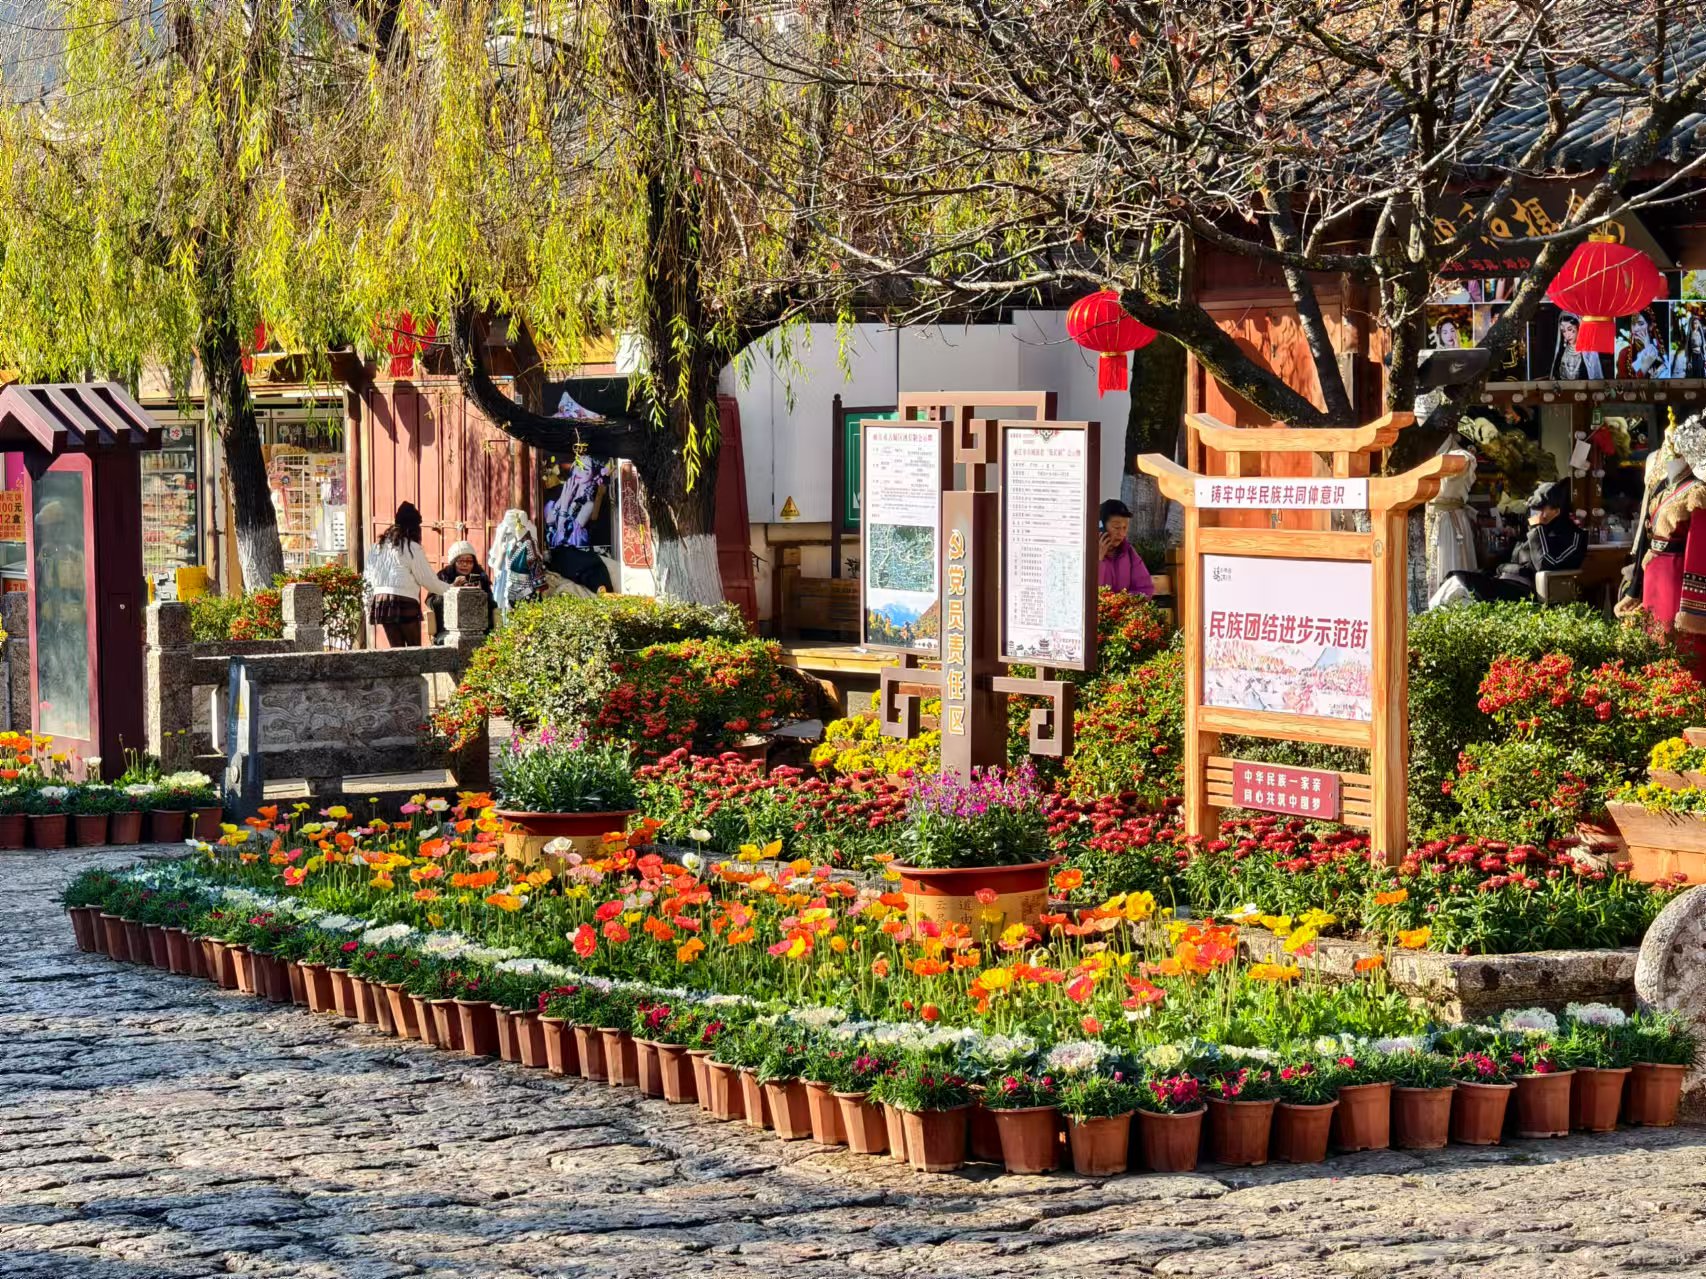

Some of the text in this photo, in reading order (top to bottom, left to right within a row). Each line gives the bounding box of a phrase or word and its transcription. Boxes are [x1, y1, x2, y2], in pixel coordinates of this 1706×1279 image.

[1211, 484, 1345, 505] 铸牢中华民族共同体意识
[1209, 611, 1369, 649] 民族团结进步示范街
[947, 564, 966, 736] 党员责任区
[1243, 769, 1321, 792] 中华民族一家亲
[1243, 788, 1321, 811] 同心共筑中国梦
